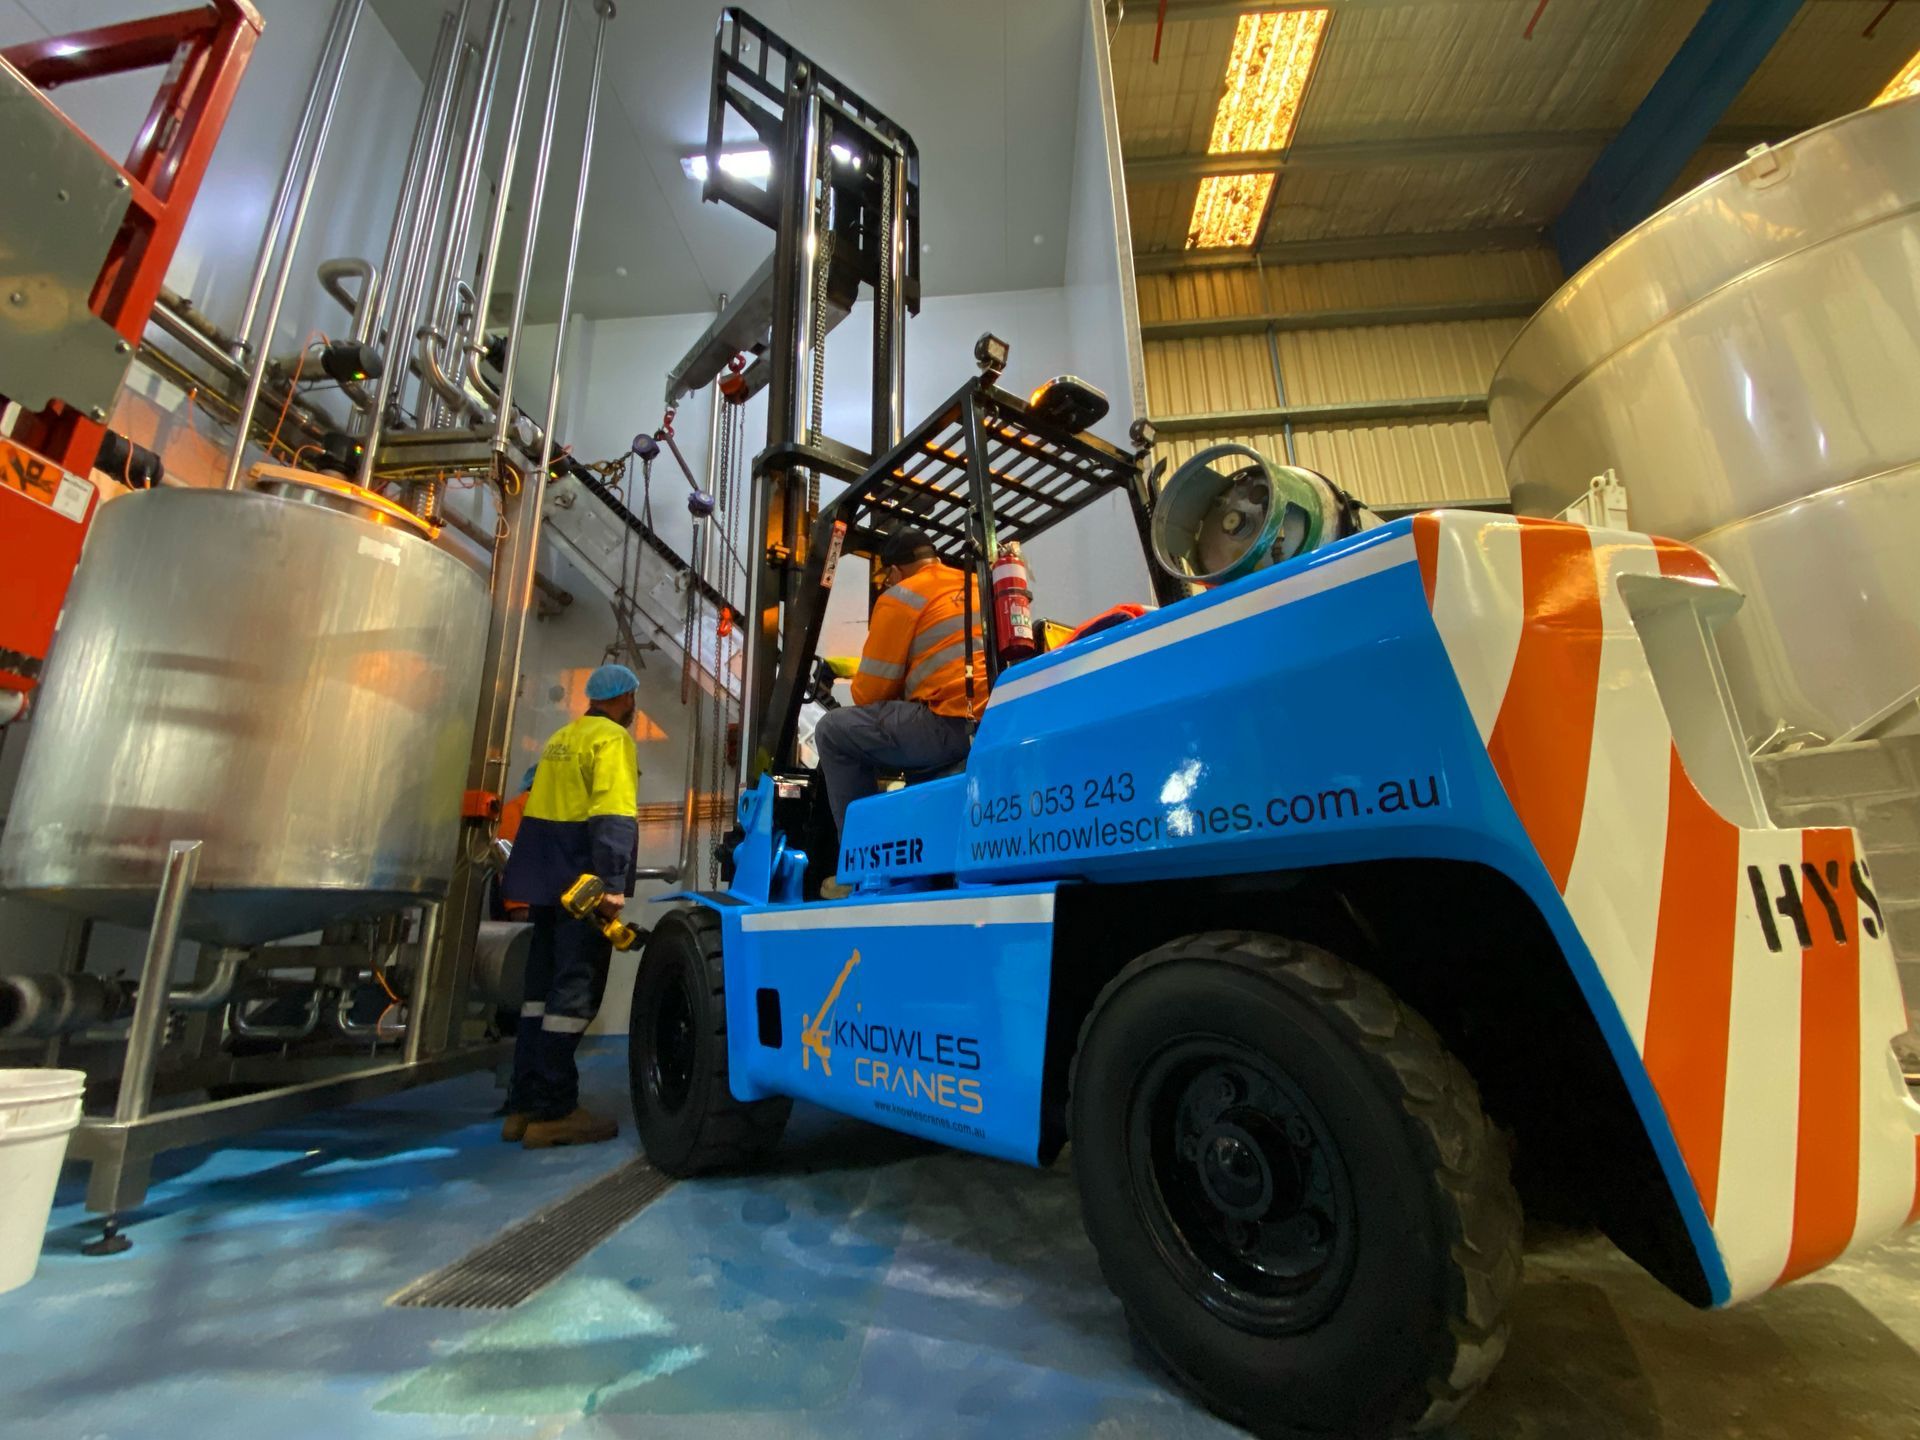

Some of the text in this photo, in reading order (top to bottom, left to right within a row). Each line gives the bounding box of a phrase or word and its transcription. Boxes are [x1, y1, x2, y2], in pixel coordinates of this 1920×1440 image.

[971, 772, 1136, 828] 0425 053 243
[845, 838, 924, 873] HYSTER
[835, 1020, 981, 1071] KNOWLES
[855, 1057, 983, 1114] CRANES
[874, 1101, 986, 1139] www.knowlescranes.com.au
